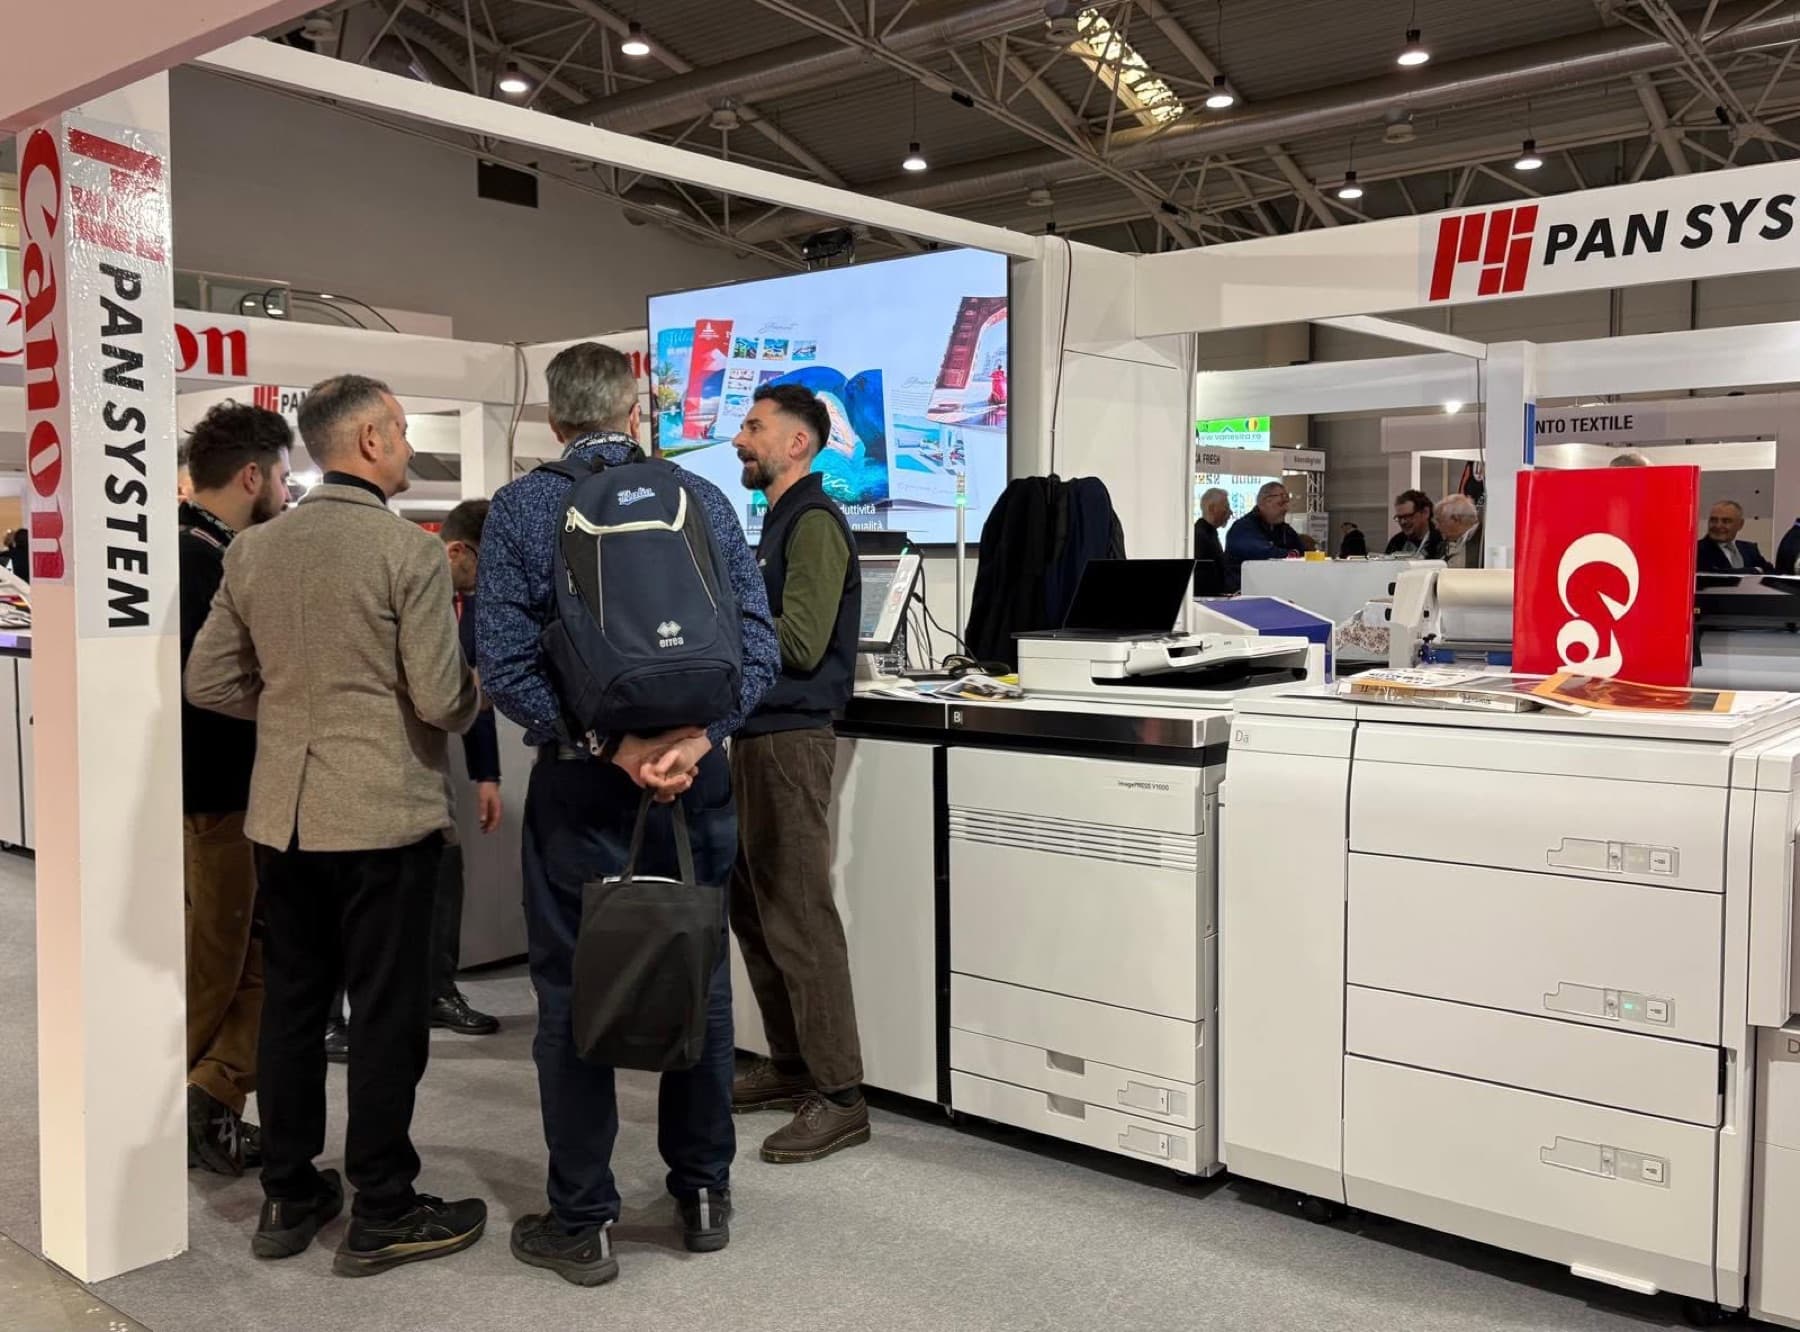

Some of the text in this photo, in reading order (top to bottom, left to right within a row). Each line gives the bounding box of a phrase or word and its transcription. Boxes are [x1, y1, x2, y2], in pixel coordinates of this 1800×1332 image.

[1543, 193, 1796, 266] PAN SYS
[20, 127, 65, 579] Canon
[99, 262, 150, 629] PAN SYSTEM
[1535, 415, 1634, 434] NTO TEXTILE
